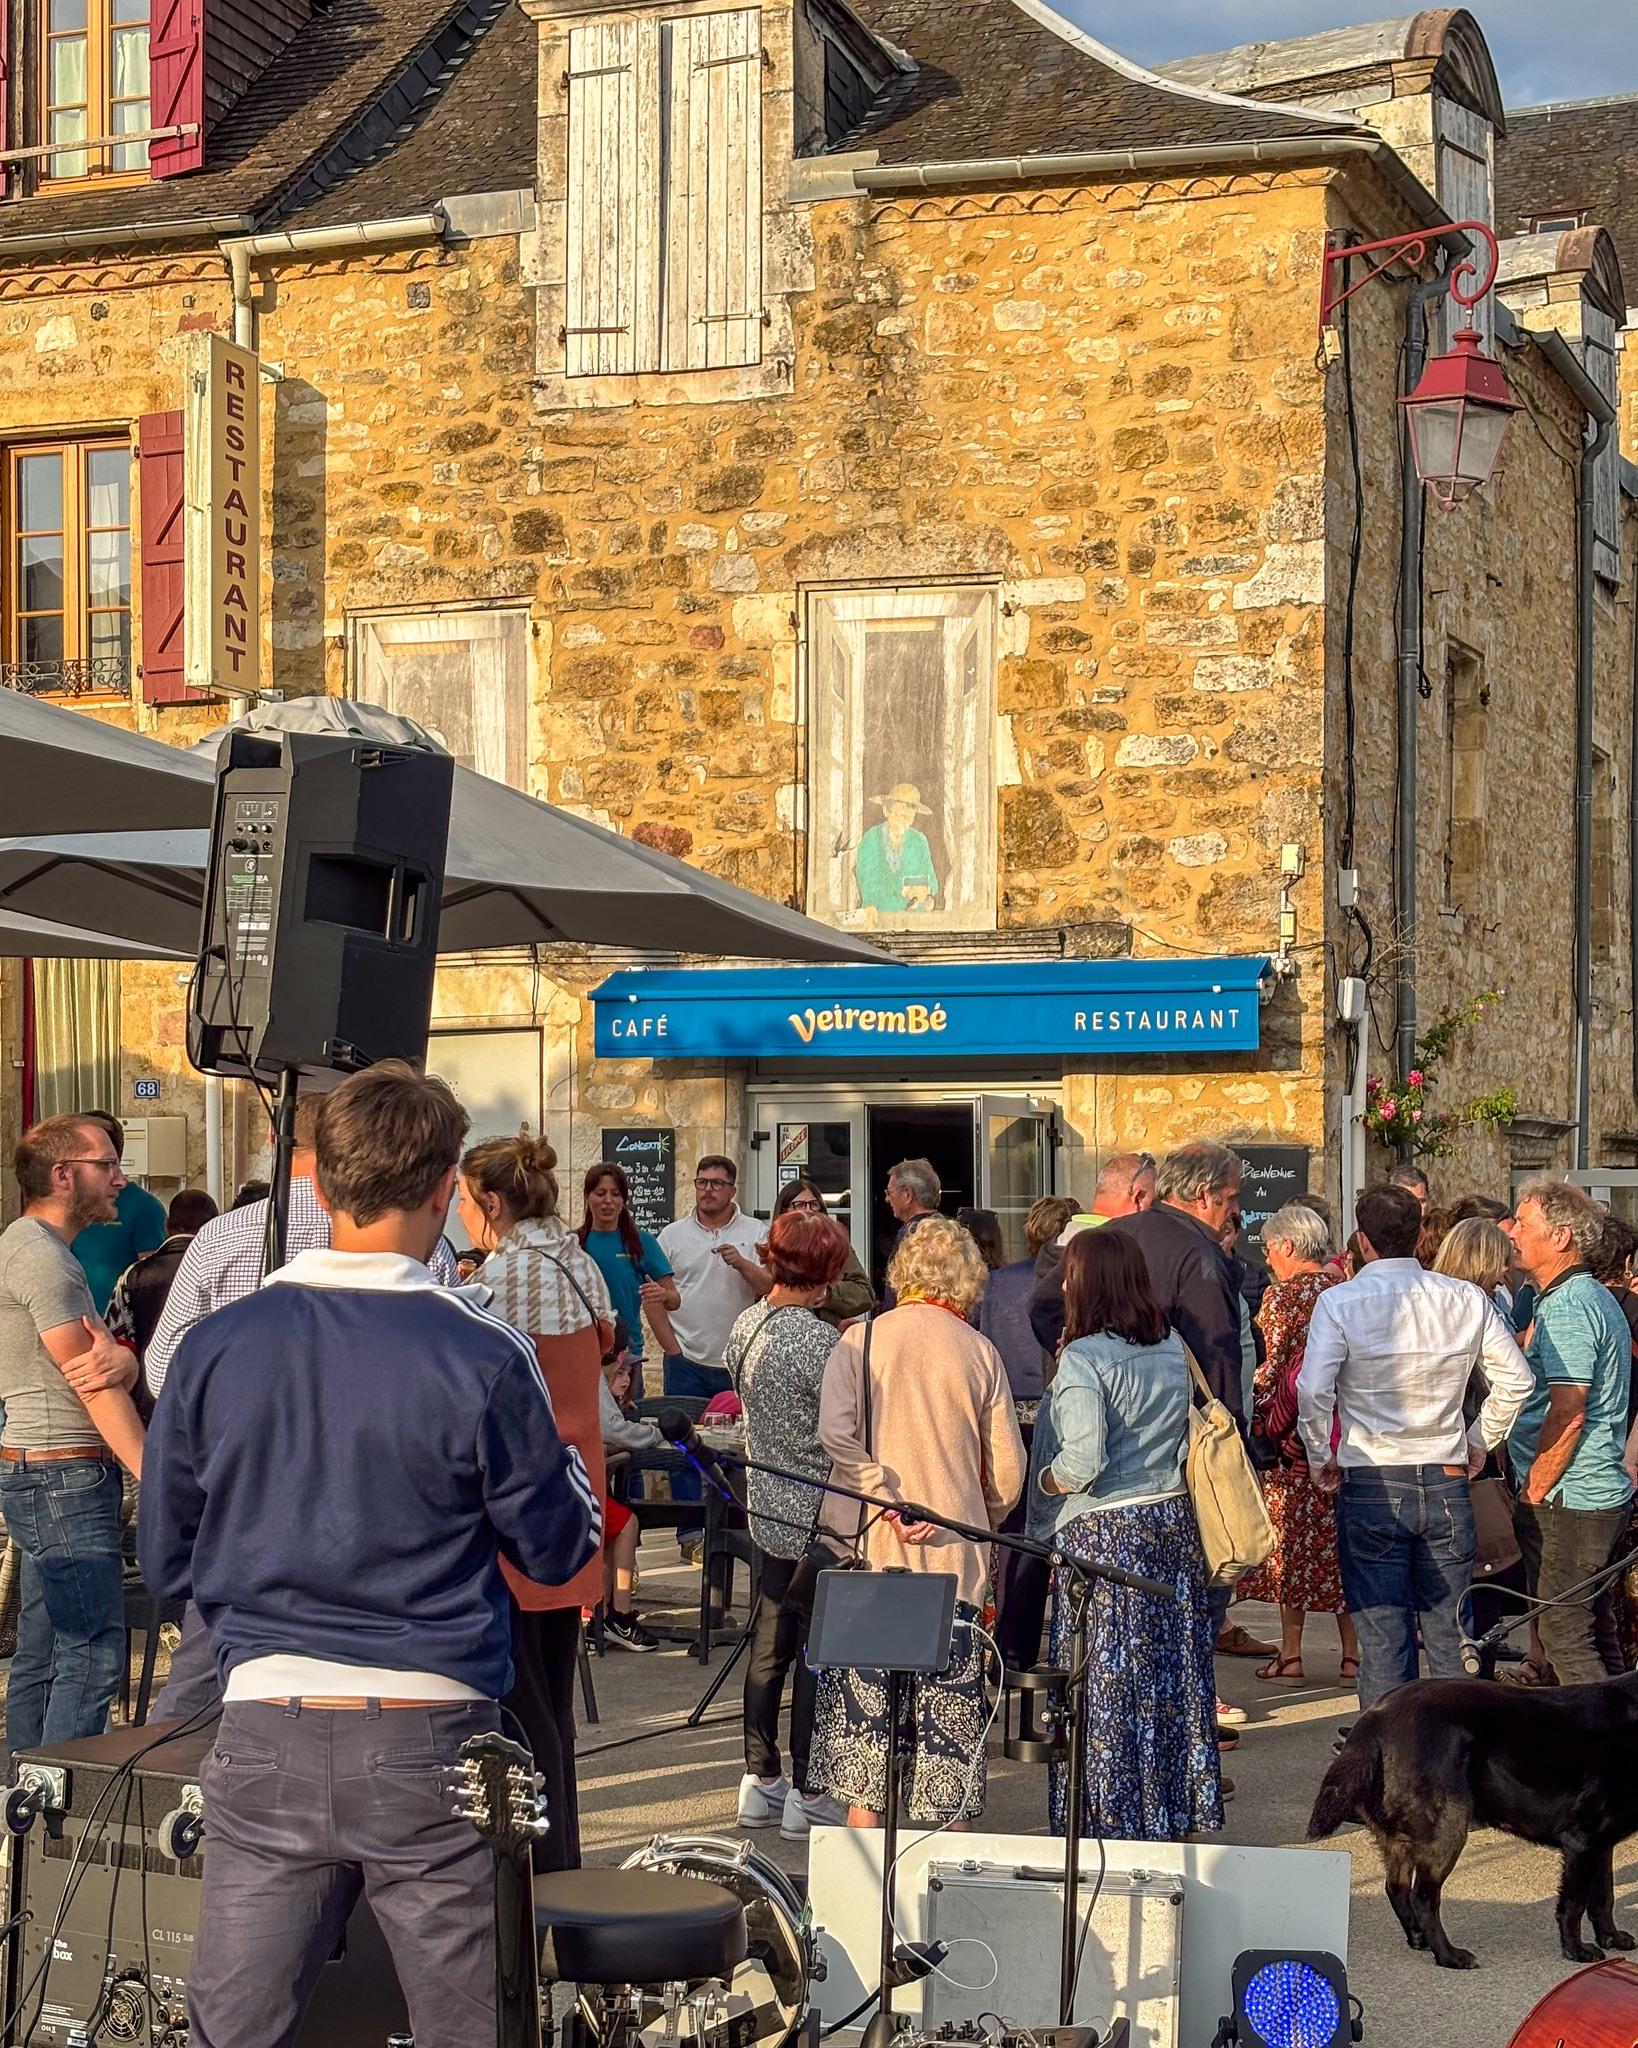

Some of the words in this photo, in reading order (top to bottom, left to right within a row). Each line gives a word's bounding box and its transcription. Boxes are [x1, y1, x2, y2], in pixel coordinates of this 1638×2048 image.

[222, 359, 249, 673] RESTAURANT
[612, 1014, 668, 1037] CAFÉ
[788, 1002, 947, 1042] VeiremBé
[1075, 1009, 1240, 1030] RESTAURANT
[138, 1082, 156, 1096] 68
[53, 1938, 68, 1949] the
[152, 1928, 164, 1941] CL
[166, 1930, 181, 1944] 115
[53, 1945, 73, 1961] box
